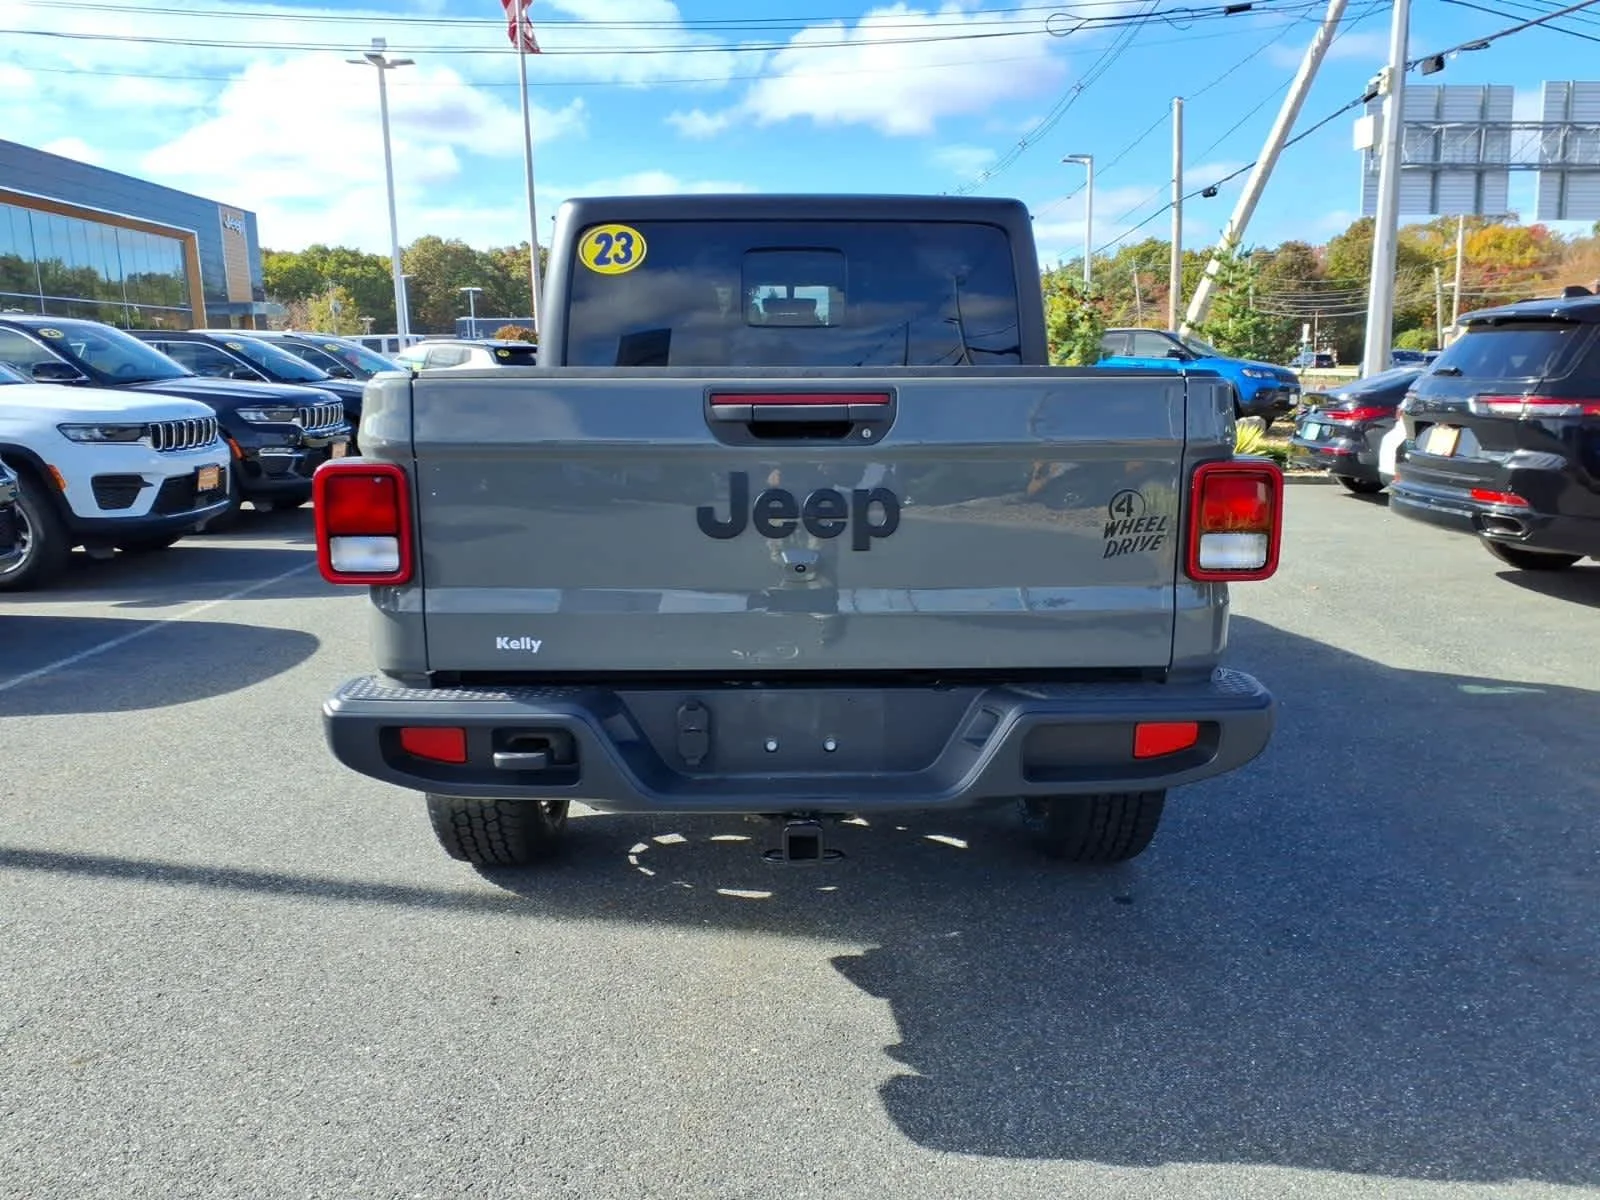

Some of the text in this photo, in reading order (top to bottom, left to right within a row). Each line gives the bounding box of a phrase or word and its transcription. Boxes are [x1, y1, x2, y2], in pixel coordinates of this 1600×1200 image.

[593, 231, 634, 266] 23
[696, 471, 900, 551] Jeep
[1115, 494, 1134, 517] 4
[1103, 516, 1167, 539] WHEEL
[1103, 534, 1165, 559] DRIVE
[496, 636, 542, 654] Kelly
